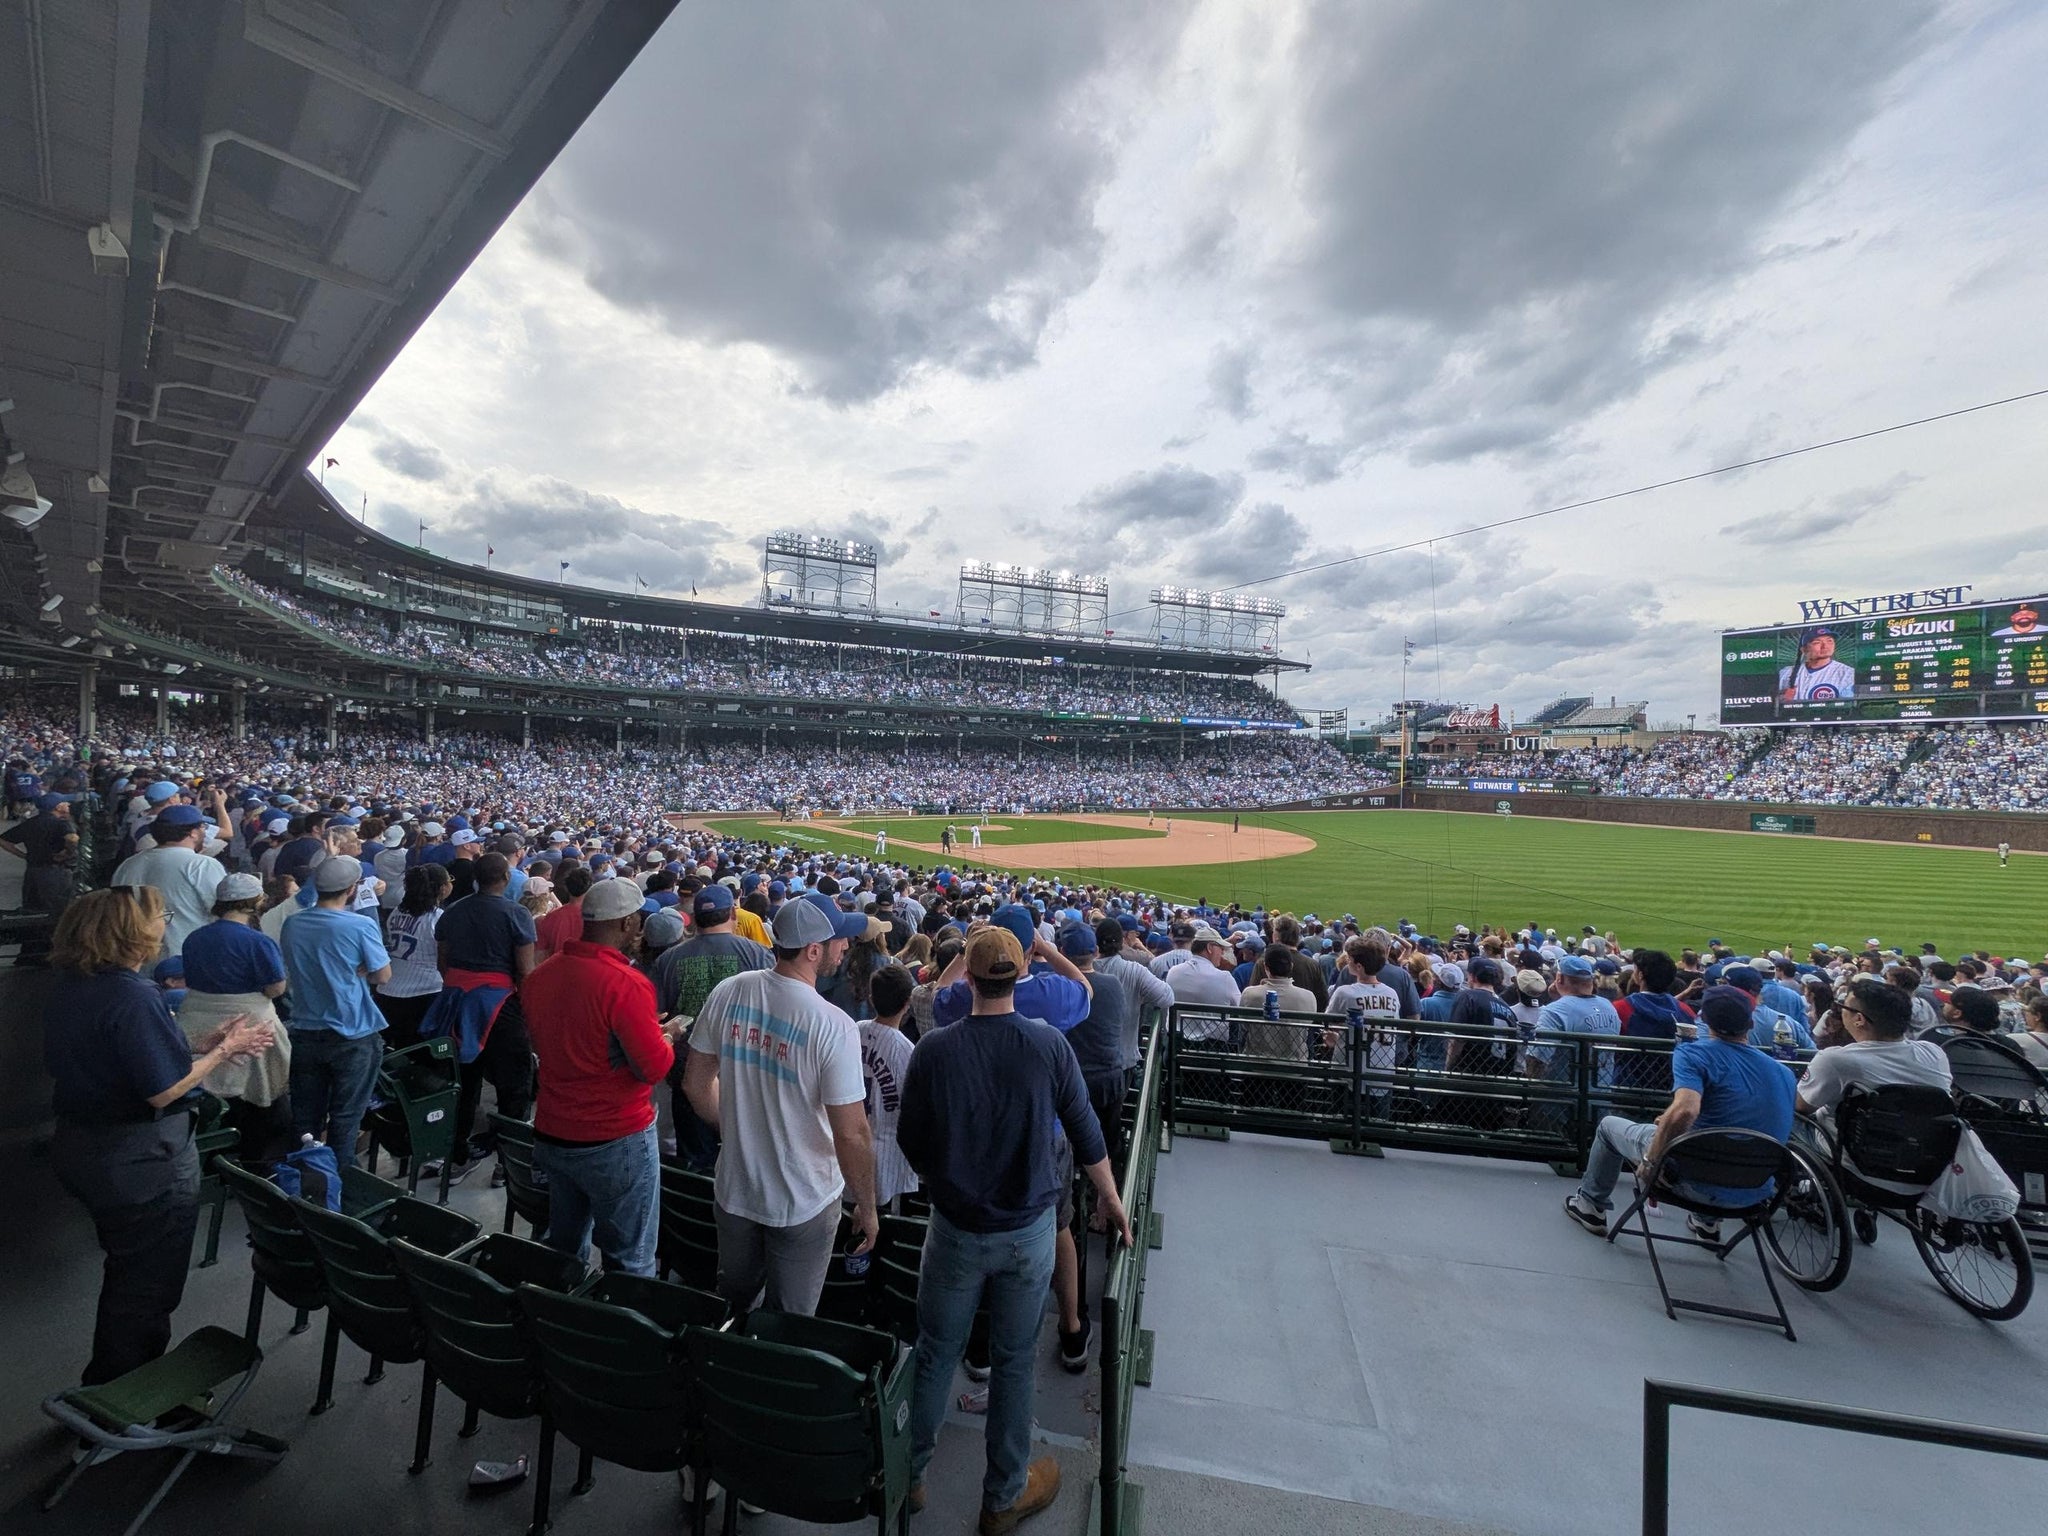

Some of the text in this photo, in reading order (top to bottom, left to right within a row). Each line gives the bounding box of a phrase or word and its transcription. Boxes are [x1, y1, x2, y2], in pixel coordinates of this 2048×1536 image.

[1797, 585, 1972, 620] WINTRUST
[1862, 621, 1876, 630] 27
[1890, 620, 1955, 637] SUZUKI
[1862, 632, 1876, 640] RF
[479, 637, 528, 648] CATALINA CLUB
[1902, 646, 1938, 654] ARAKAWA,
[1940, 644, 1963, 652] JAPAN
[1740, 650, 1773, 660] BOSCH
[1894, 662, 1910, 670] 571
[1952, 658, 1970, 666] .245
[1725, 695, 1772, 704] nuveen
[1900, 710, 1932, 718] SHAKIRA
[1473, 782, 1514, 791] CUTWATER
[1369, 796, 1386, 806] YETI
[1356, 996, 1397, 1012] SKENES
[1584, 1012, 1619, 1031] SUZUKI
